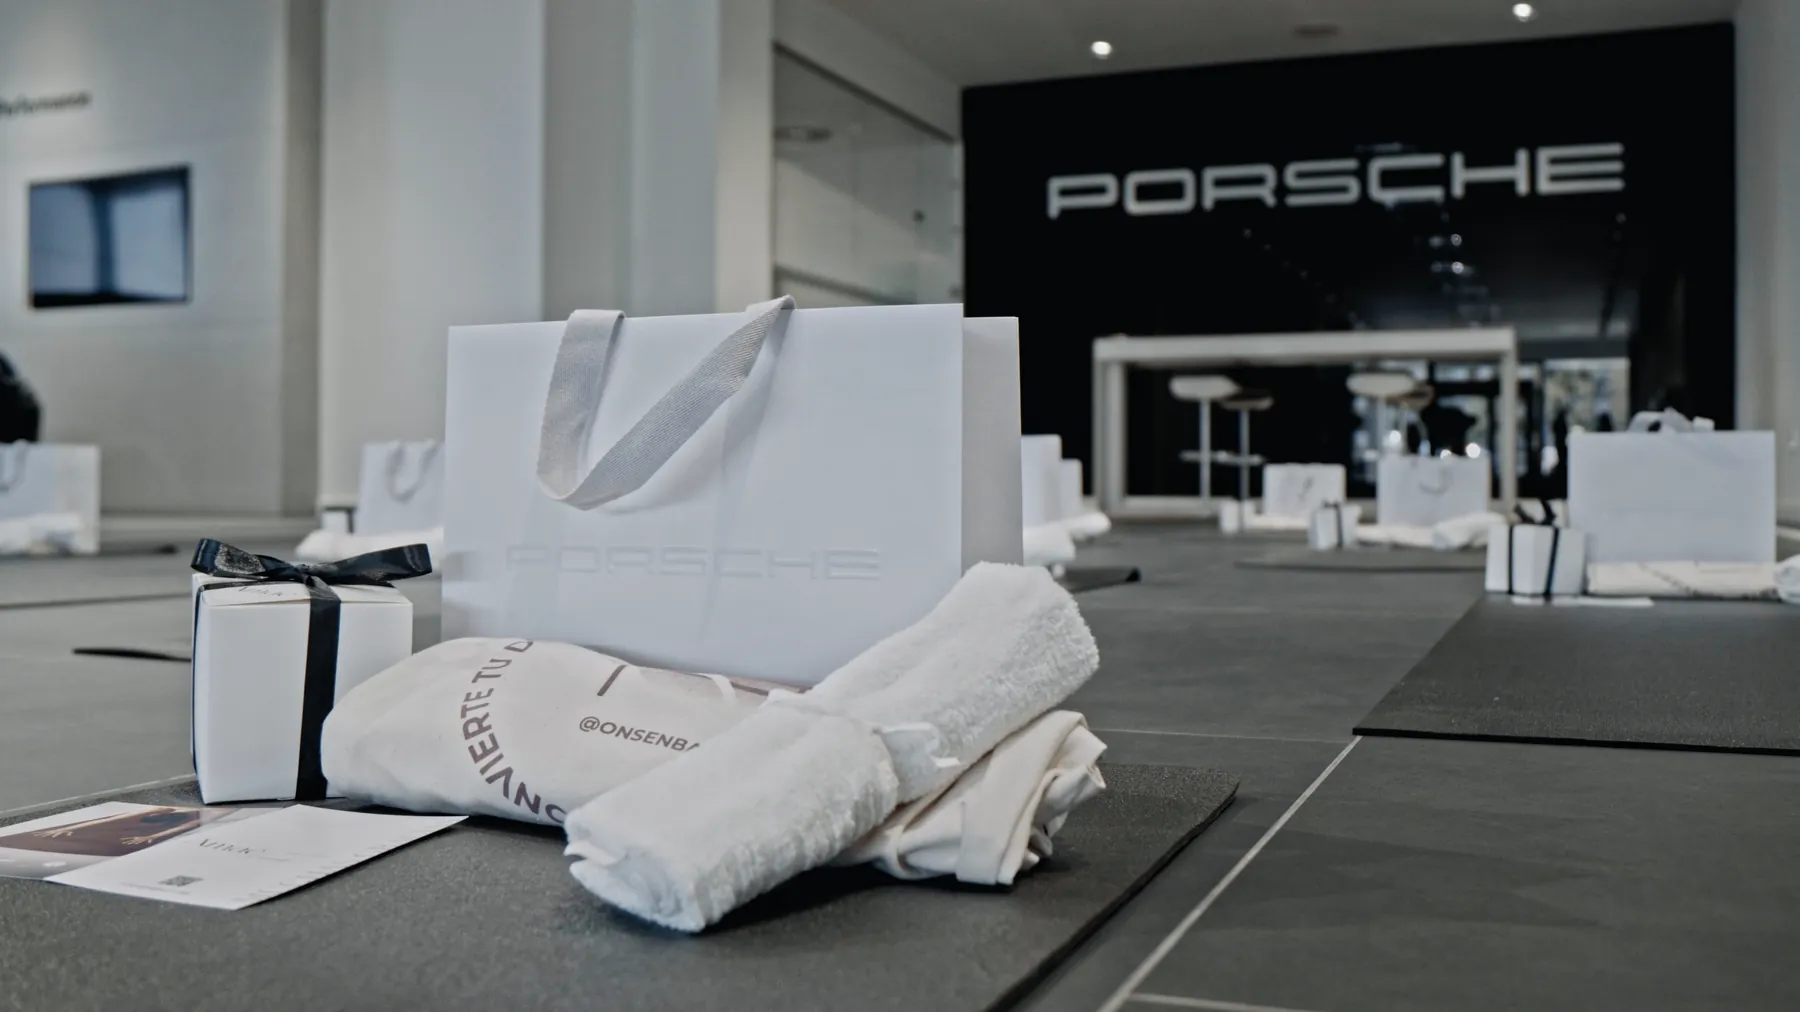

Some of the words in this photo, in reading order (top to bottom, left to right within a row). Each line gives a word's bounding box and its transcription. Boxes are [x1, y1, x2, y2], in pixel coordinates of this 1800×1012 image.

[1046, 142, 1626, 219] PORSCHE
[506, 545, 880, 580] PORSCHE
[471, 658, 513, 684] TU
